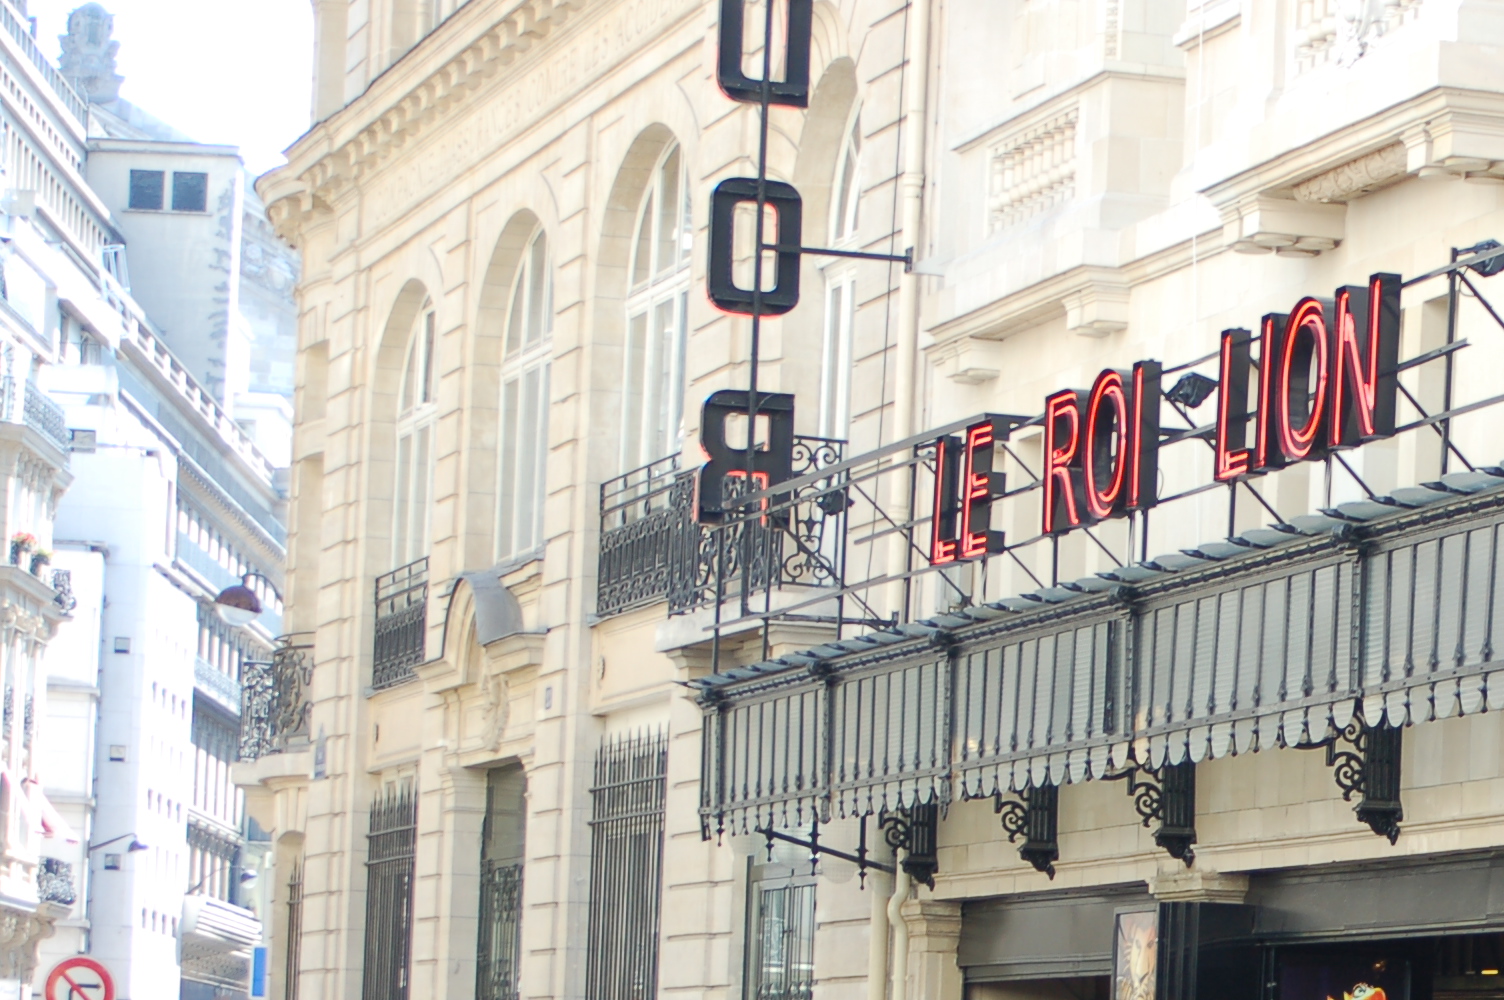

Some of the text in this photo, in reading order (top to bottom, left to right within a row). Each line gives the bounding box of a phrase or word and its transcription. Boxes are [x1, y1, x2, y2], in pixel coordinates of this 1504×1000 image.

[929, 272, 1402, 566] LE ROI LION
